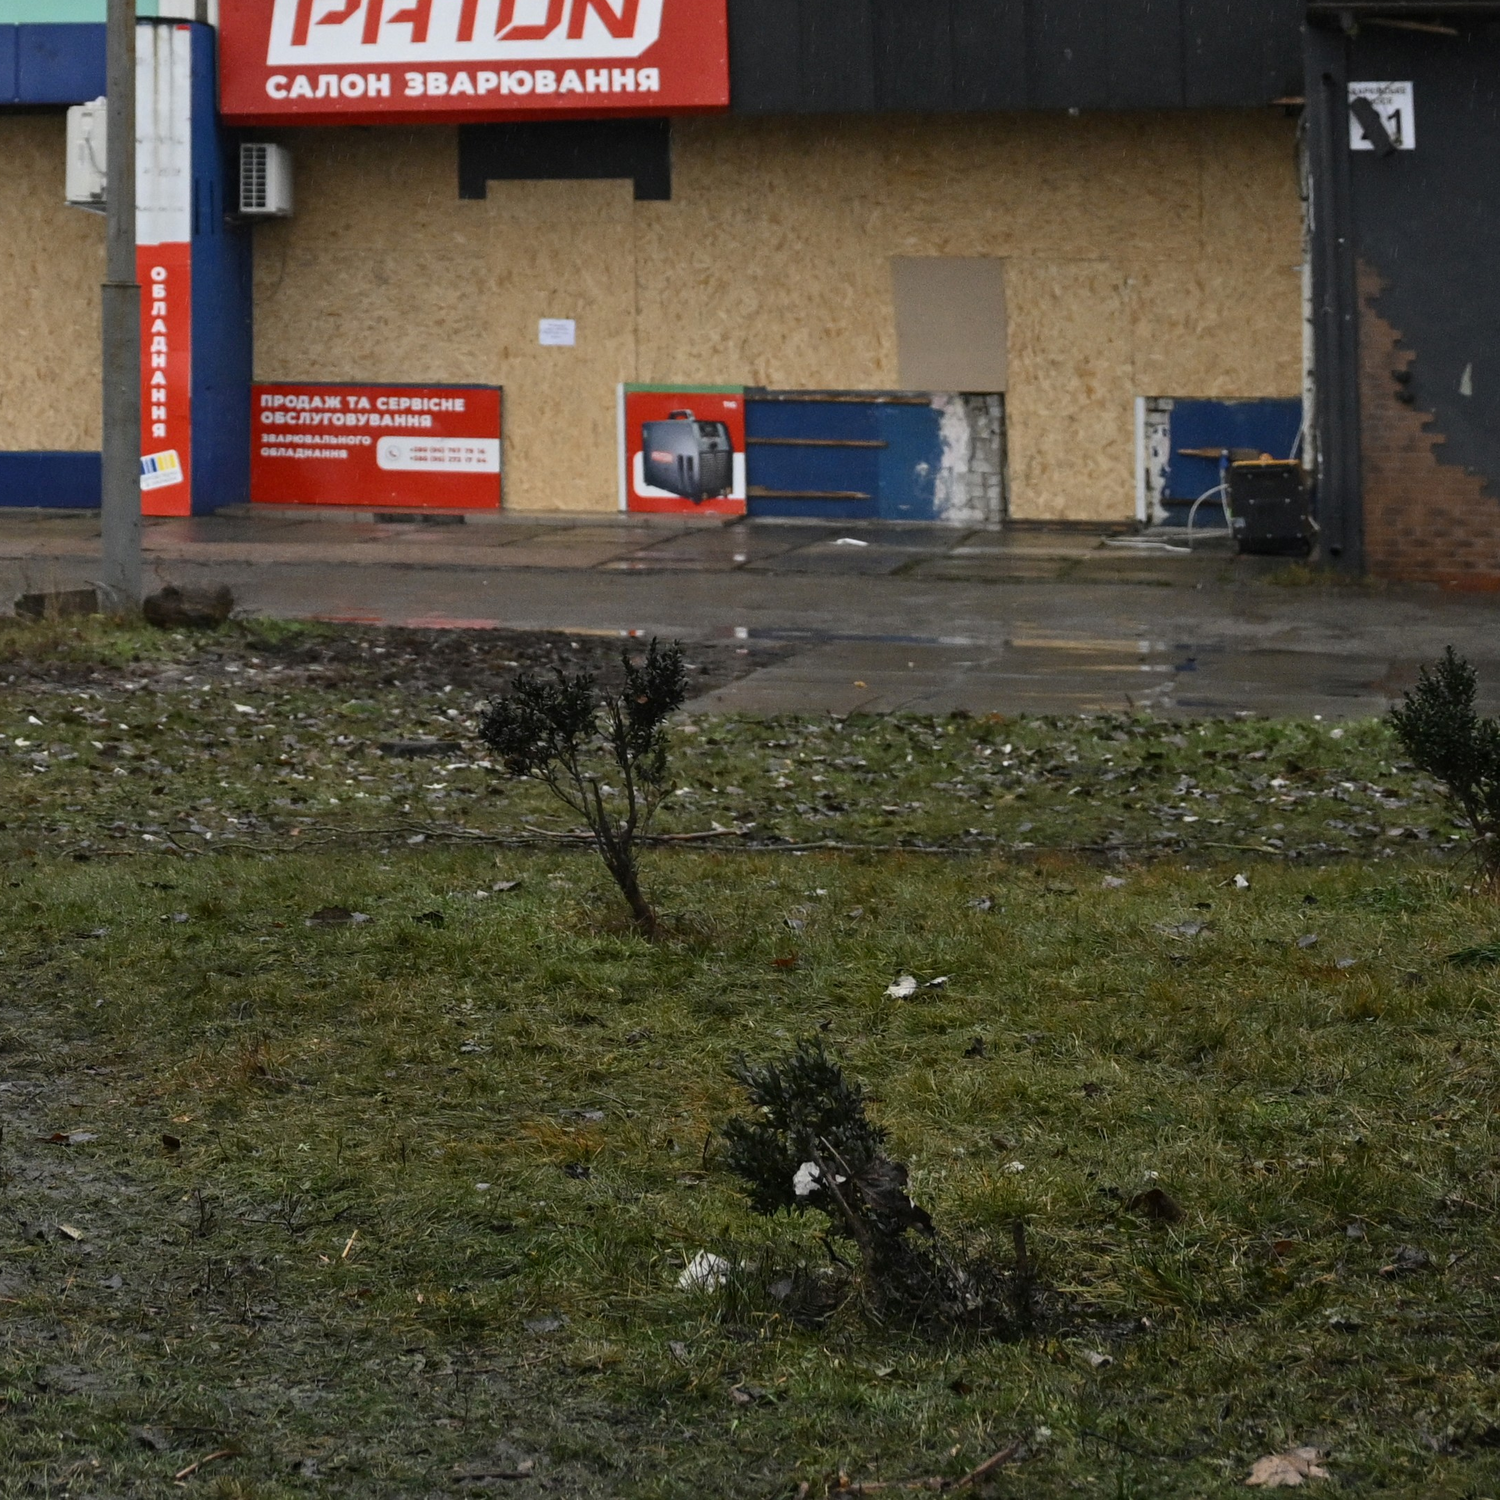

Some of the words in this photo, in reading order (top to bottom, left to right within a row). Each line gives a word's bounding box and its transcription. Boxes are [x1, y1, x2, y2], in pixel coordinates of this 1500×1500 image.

[265, 73, 391, 99] САЛОН
[404, 67, 660, 96] ЗВАРЮВАННЯ
[150, 265, 168, 438] ОБЛАДНАННЯ
[260, 394, 342, 410] ПРОДАЖ
[346, 396, 371, 409] ТА
[376, 397, 466, 412] СЕРВІСНЕ
[260, 411, 433, 428] ОБСЛУГОВУВАННЯ
[260, 433, 372, 446] ЗВАРЮВАЛЬНОГО
[260, 446, 349, 460] ОБЛАДНАННЯ
